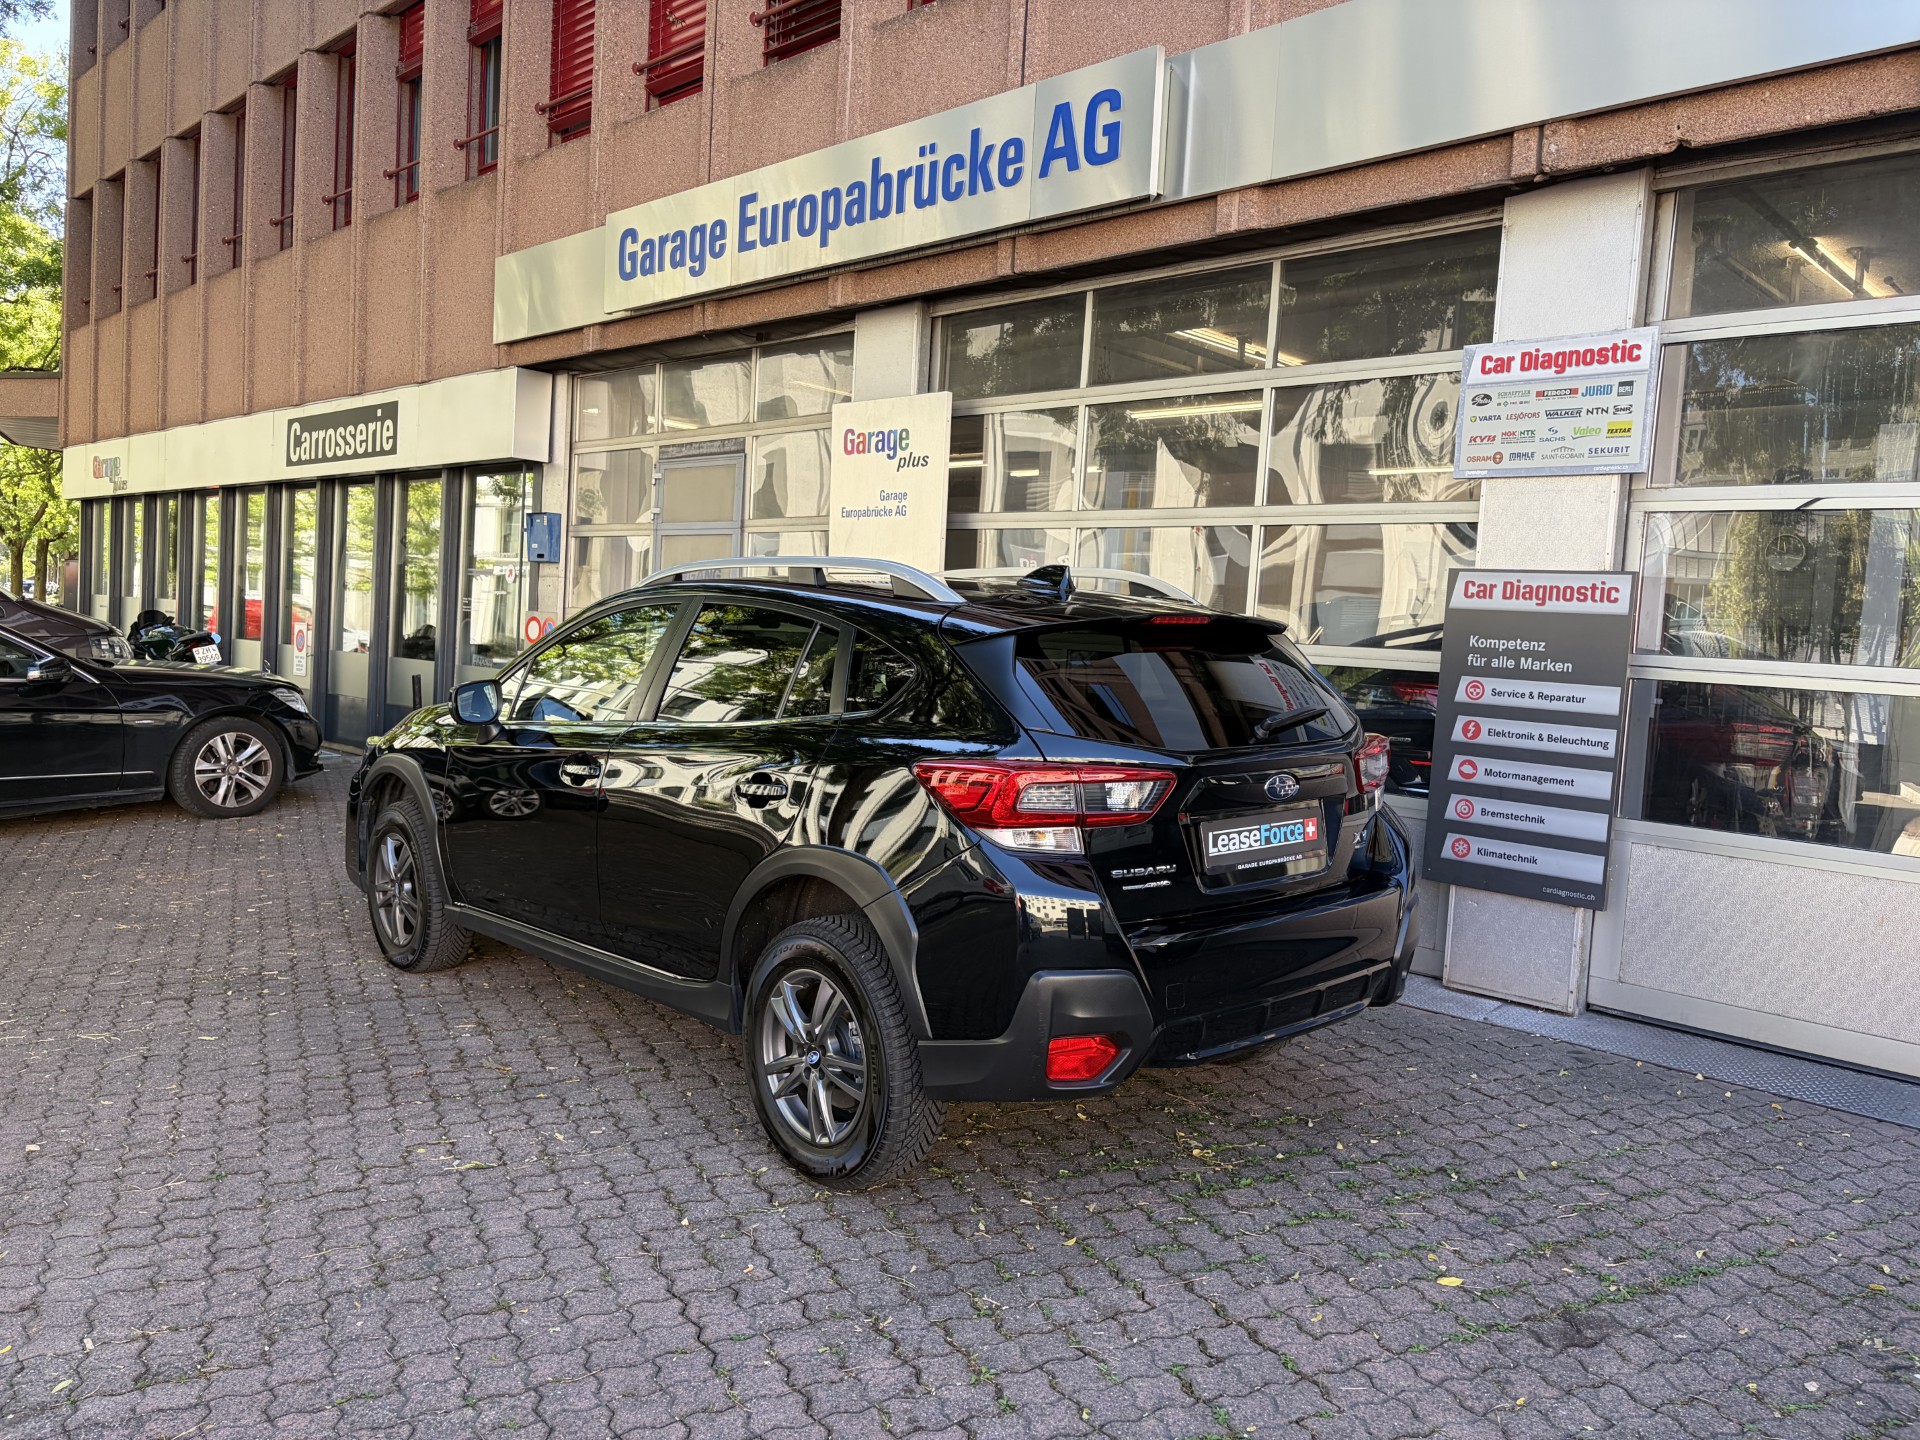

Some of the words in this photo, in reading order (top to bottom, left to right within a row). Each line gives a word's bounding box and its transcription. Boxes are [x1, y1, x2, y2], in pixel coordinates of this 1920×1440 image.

[618, 216, 727, 281] Garage
[737, 127, 1025, 254] Europabrücke
[1038, 88, 1123, 179] AG
[1481, 354, 1515, 375] Car
[1519, 339, 1642, 374] Diagnostic
[1543, 389, 1572, 397] FERODO
[1581, 384, 1613, 397] JURID
[1478, 414, 1502, 422] VARTA
[1545, 408, 1583, 418] WALKER
[1586, 406, 1609, 416] NTN
[289, 409, 394, 463] Carrosserie
[1573, 425, 1602, 436] Valeo
[843, 428, 910, 460] Garage
[1588, 446, 1631, 454] SEKURIT
[896, 452, 930, 472] plus
[1466, 455, 1492, 463] OSRAM
[92, 456, 121, 483] Garage
[879, 489, 908, 503] Garage
[841, 505, 893, 520] Europabrücke
[894, 504, 907, 517] AG
[1463, 579, 1498, 600] Car
[1501, 580, 1620, 607] Diagnostic
[1469, 635, 1546, 653] Kompetenz
[1467, 653, 1488, 669] für
[1491, 655, 1515, 670] alle
[1519, 657, 1573, 673] Marken
[1491, 687, 1527, 699] Service
[1528, 690, 1535, 700] &
[1537, 691, 1587, 704] Reparatur
[1487, 728, 1536, 742] Elektronik
[1537, 732, 1545, 742] &
[1547, 733, 1610, 751] Beleuchtung
[1484, 767, 1575, 788] Motormanagement
[1480, 807, 1546, 826] Bremstechnik
[1208, 823, 1304, 854] LeaseForce
[1476, 847, 1539, 866] Klimatechnik
[1111, 864, 1176, 878] SUBARU
[1237, 861, 1258, 870] GARAGE
[1542, 886, 1596, 901] cardiagnostic.ch
